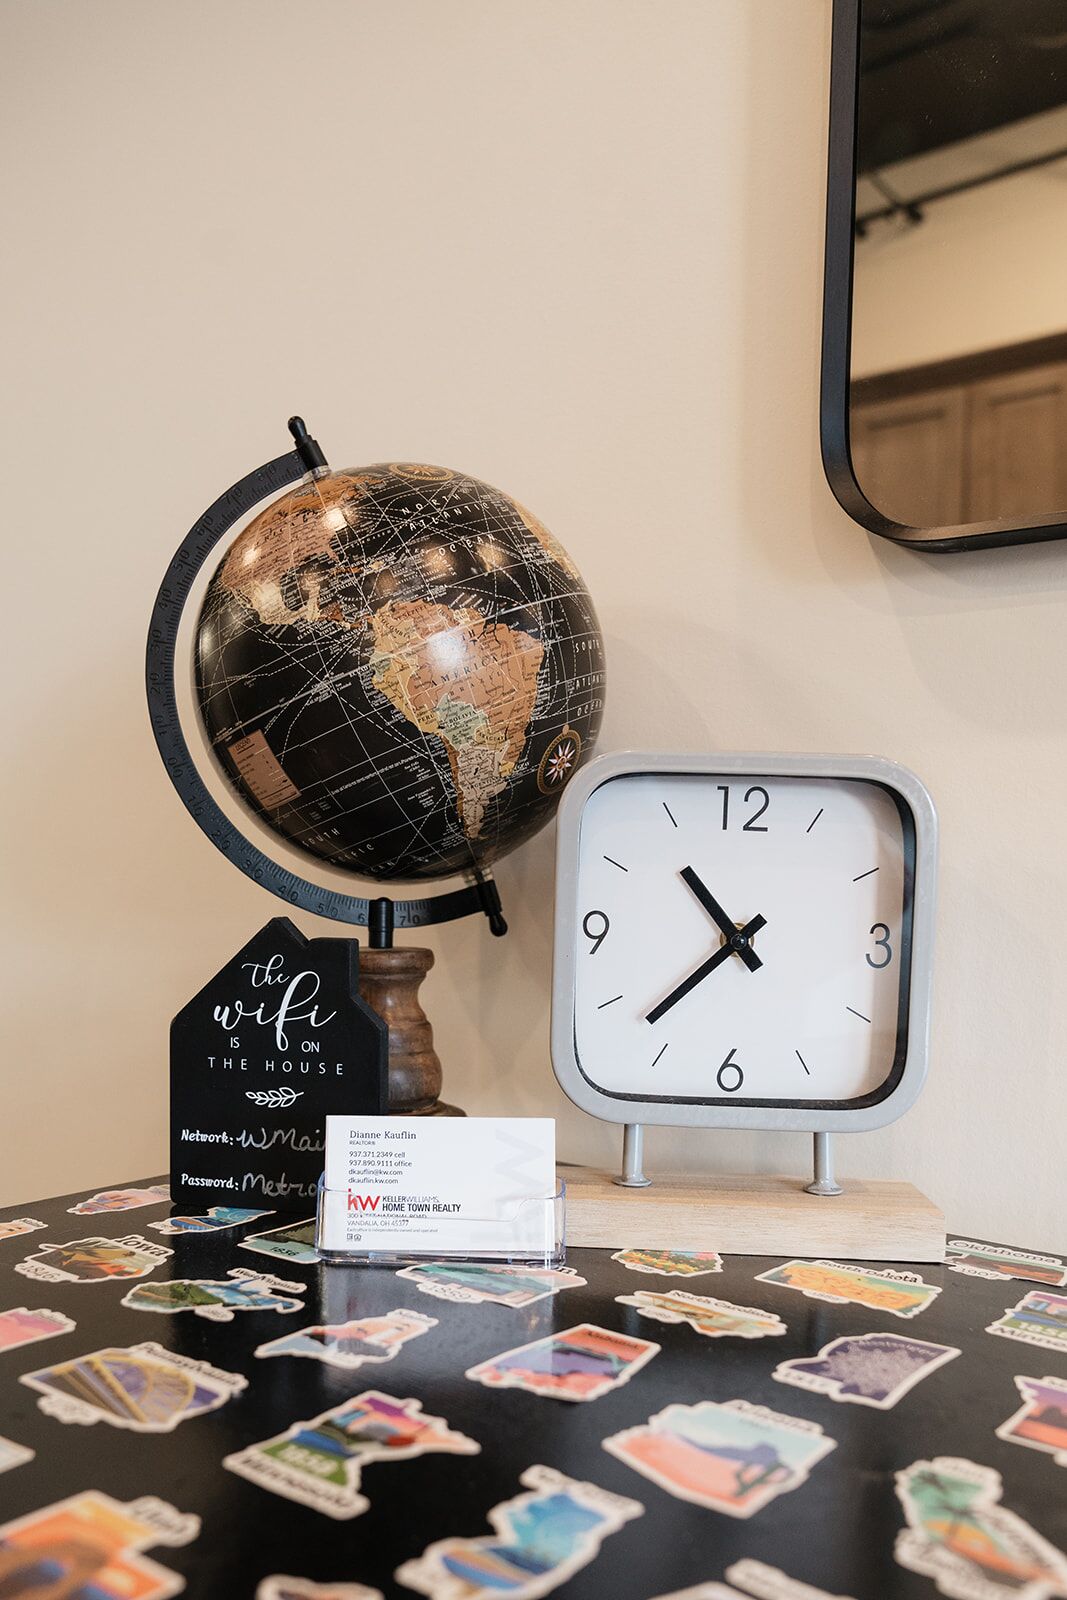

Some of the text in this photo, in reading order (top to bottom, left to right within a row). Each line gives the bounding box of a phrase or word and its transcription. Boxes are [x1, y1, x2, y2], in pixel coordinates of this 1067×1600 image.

[401, 493, 461, 515] NORTH
[409, 502, 490, 531] ATLANTIC
[438, 533, 496, 556] OCEAN
[717, 785, 770, 832] 12
[242, 859, 264, 879] 30
[278, 885, 299, 902] 40
[316, 903, 338, 918] 50
[399, 914, 421, 926] 70
[582, 910, 610, 955] 9
[865, 923, 893, 969] 3
[213, 971, 337, 1051] wifi
[230, 1036, 320, 1053] IS ON
[207, 1056, 344, 1075] THE HOUSE
[716, 1048, 744, 1092] 6
[181, 1127, 326, 1151] Network: WMai
[349, 1130, 417, 1139] Dianne Kauflin
[348, 1159, 393, 1167] 937.890.9111
[349, 1150, 393, 1158] 937.371.2349
[181, 1173, 239, 1191] Password:
[348, 1168, 403, 1176] dkauflin@kw.com
[347, 1188, 381, 1211] kw
[382, 1203, 461, 1212] HOME TOWN REALTY
[114, 1235, 169, 1257] Iowa
[953, 1241, 1056, 1264] Oklahoma
[819, 1261, 918, 1283] South Dakota
[672, 1291, 774, 1320] North Carolina
